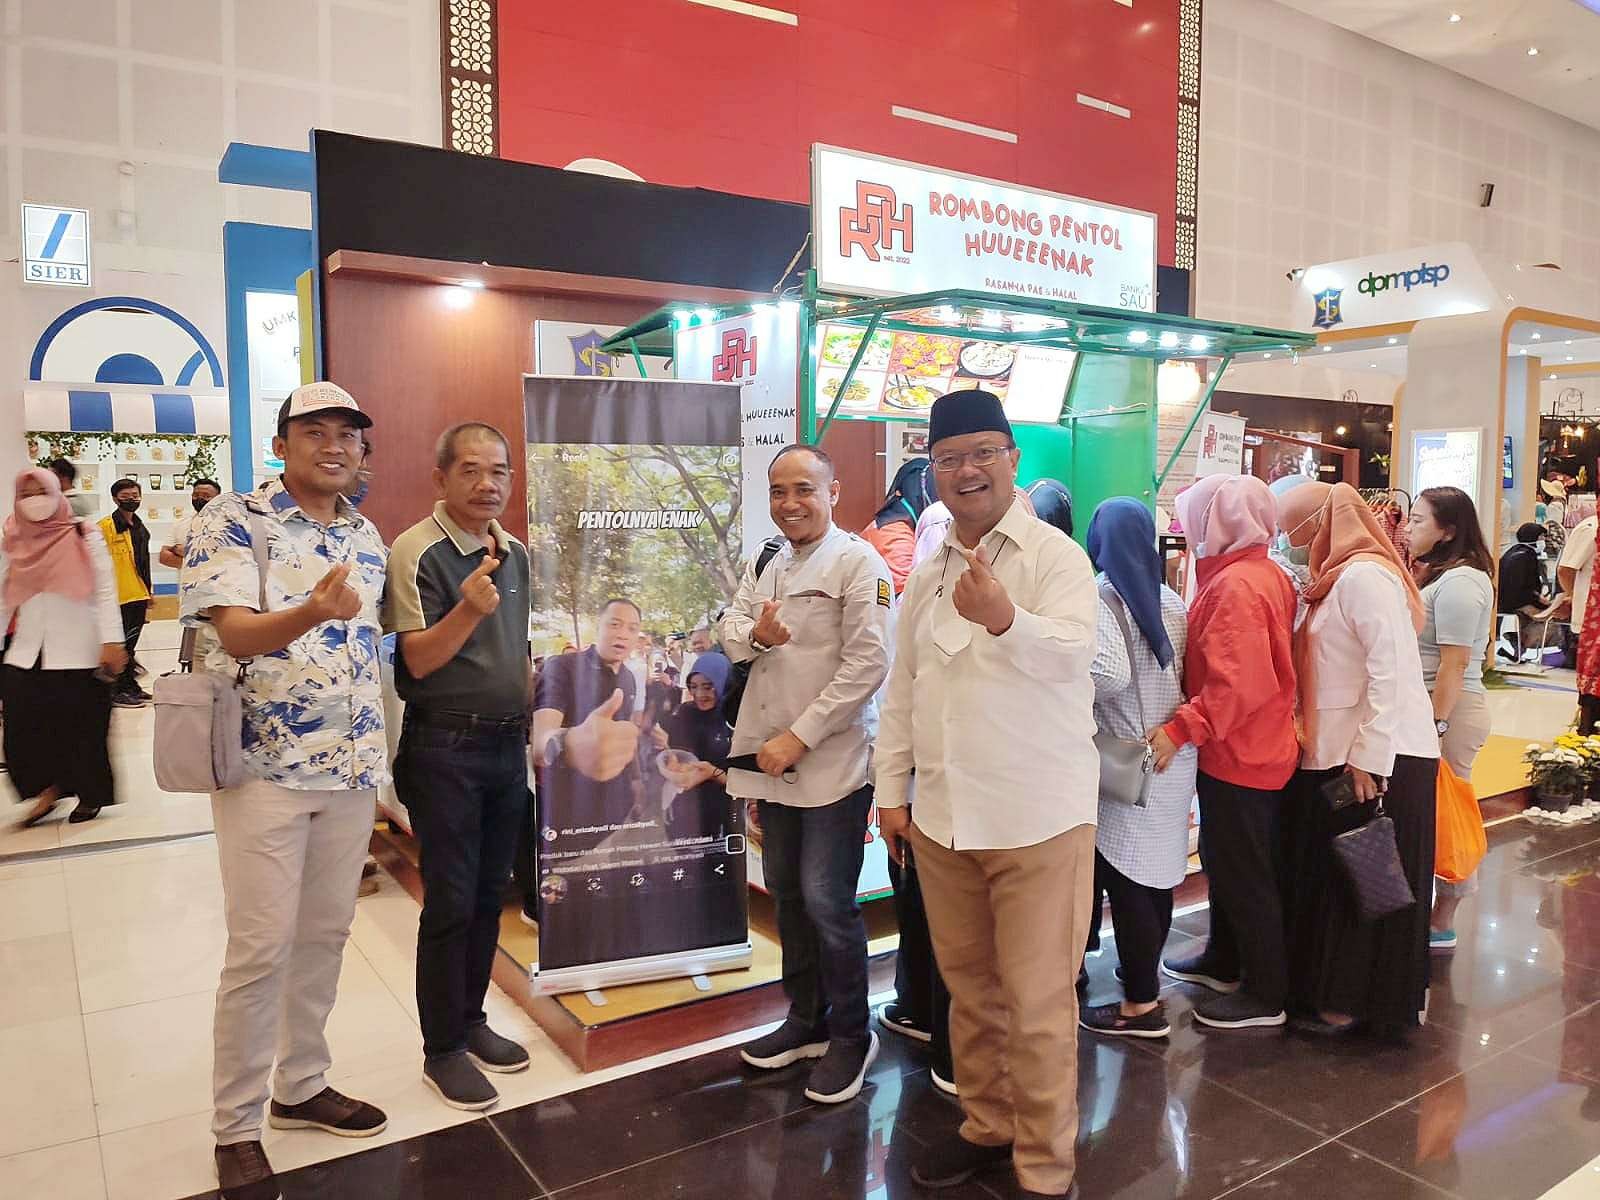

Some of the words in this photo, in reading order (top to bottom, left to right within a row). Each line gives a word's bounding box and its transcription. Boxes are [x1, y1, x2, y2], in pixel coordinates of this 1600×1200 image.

[929, 191, 1043, 237] ROMBONG
[1049, 214, 1123, 251] PENTOL
[965, 230, 1094, 278] HUUEEENAK
[31, 264, 83, 280] SIER
[1052, 288, 1078, 300] HALAL
[1119, 292, 1147, 310] SAU
[746, 407, 796, 422] HUUEEENAK
[755, 433, 785, 446] HALAL
[577, 510, 659, 529] PENTOLNYA
[660, 510, 700, 529] ENAK
